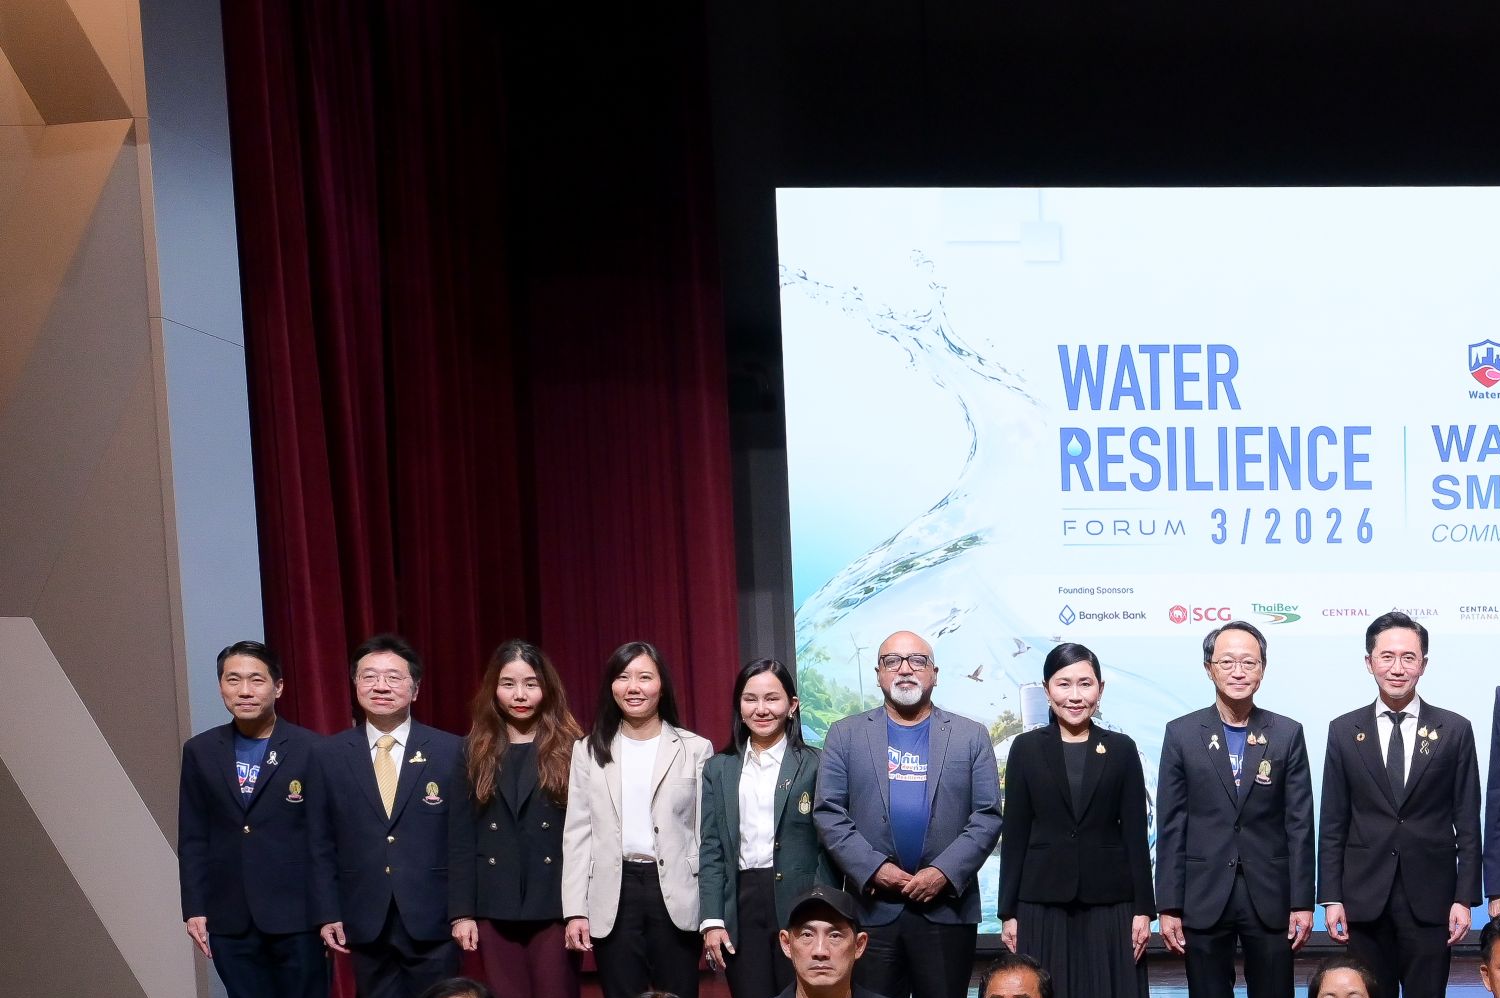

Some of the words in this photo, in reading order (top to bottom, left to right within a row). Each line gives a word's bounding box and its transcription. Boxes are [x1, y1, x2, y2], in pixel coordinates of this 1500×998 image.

[1057, 344, 1242, 411] WATER
[1059, 425, 1373, 492] RESILIENCE
[1063, 519, 1186, 537] FORUM
[1210, 507, 1373, 545] 3/2026
[1058, 586, 1095, 595] Founding
[1096, 586, 1134, 595] Sponsors
[1251, 603, 1300, 612] ThaiBev
[1322, 608, 1370, 617] CENTRAL
[1459, 605, 1499, 613] CENTRAL
[1079, 610, 1120, 621] Bangkok
[1122, 610, 1147, 620] Bank
[1192, 607, 1232, 622] SCG
